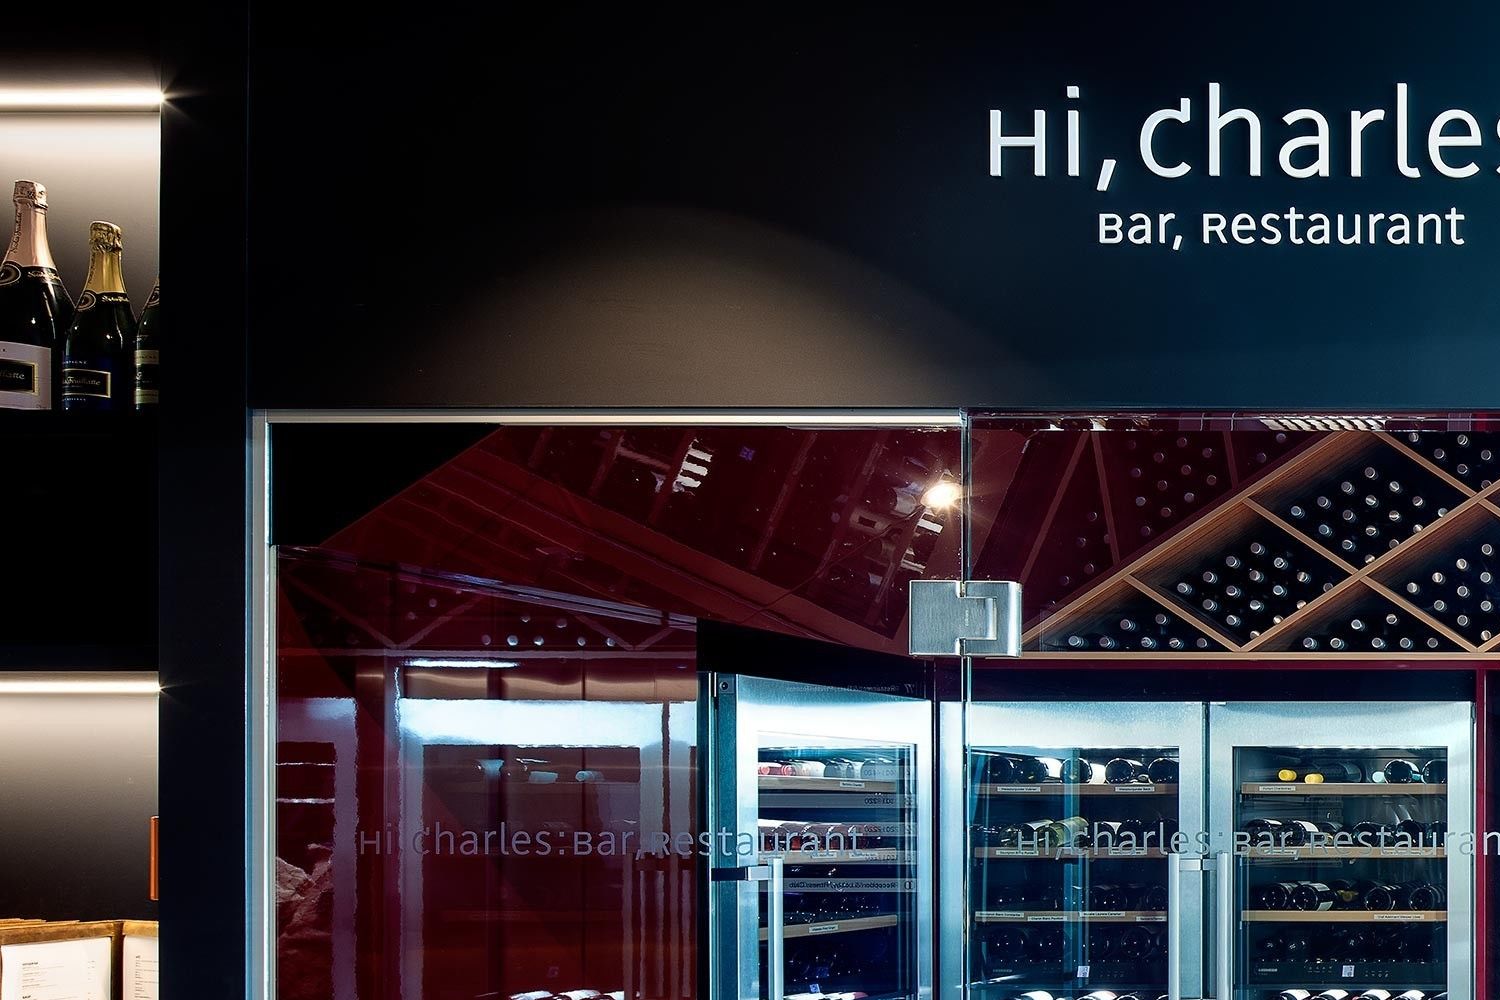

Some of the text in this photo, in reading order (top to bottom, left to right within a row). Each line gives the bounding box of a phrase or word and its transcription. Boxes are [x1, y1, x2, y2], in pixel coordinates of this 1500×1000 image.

[988, 85, 1116, 192] Hi,
[1099, 206, 1466, 252] Bar, Restaurant
[651, 826, 864, 858] Restaurant
